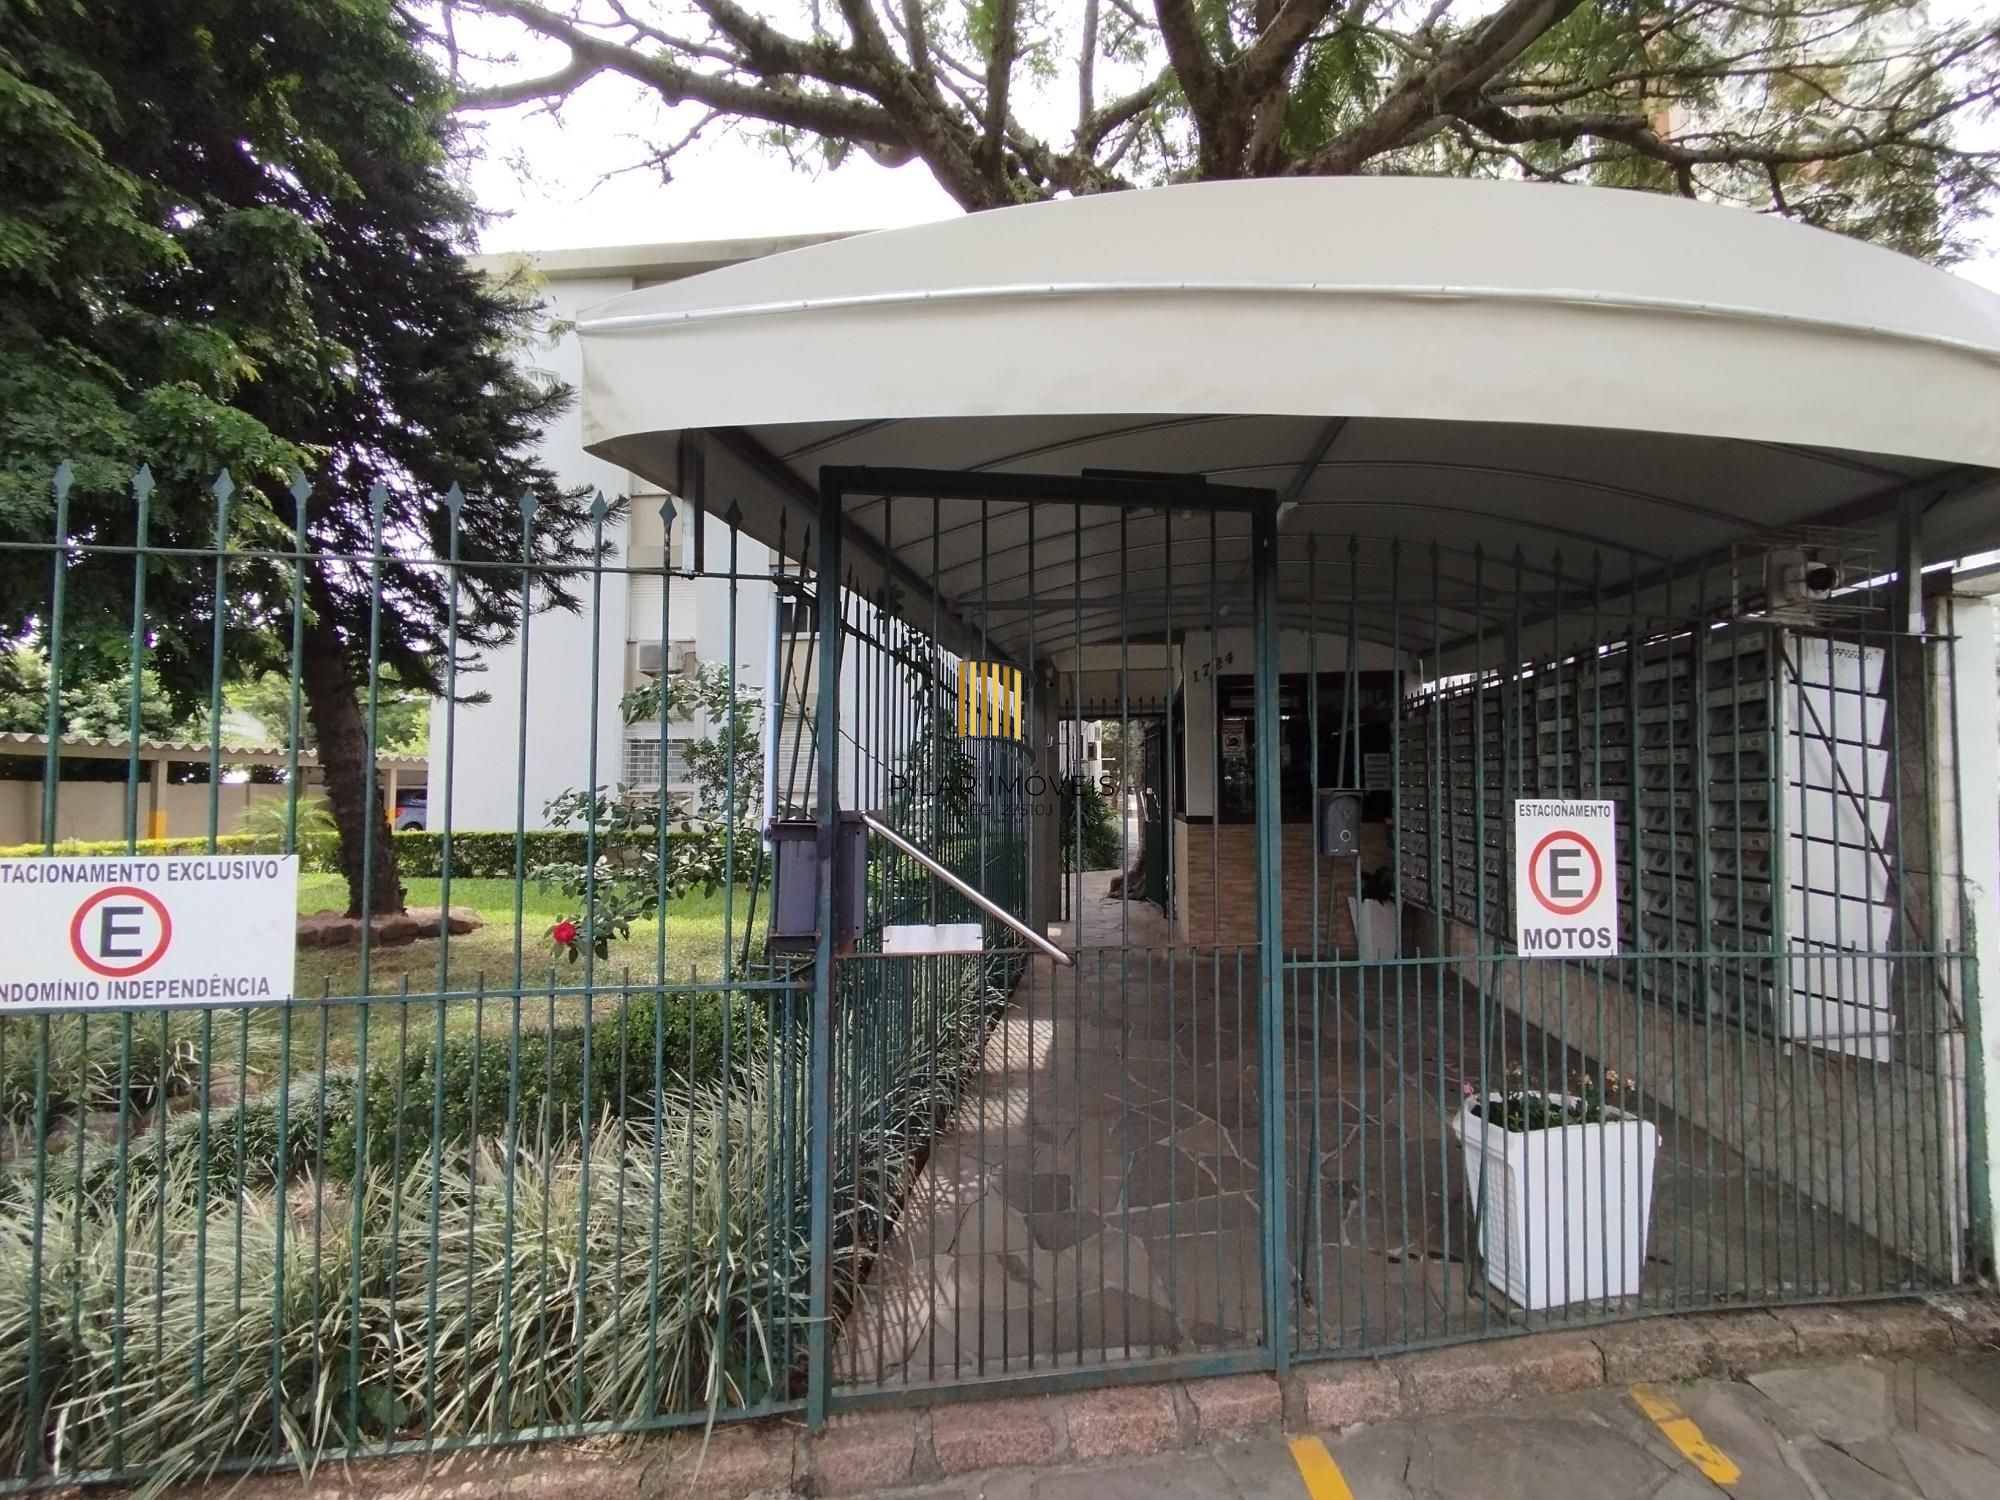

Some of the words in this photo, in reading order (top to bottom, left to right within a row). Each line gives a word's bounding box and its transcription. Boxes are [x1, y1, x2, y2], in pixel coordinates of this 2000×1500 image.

[1519, 804, 1611, 818] ESTACIONAMENTO
[1, 863, 160, 884] TACIONAMENTO
[167, 860, 279, 882] EXCLUSIVO
[1549, 849, 1583, 898] E
[100, 906, 144, 957] E
[1523, 927, 1612, 950] MOTOS
[107, 973, 271, 1000] INDEPENDÊNCIA
